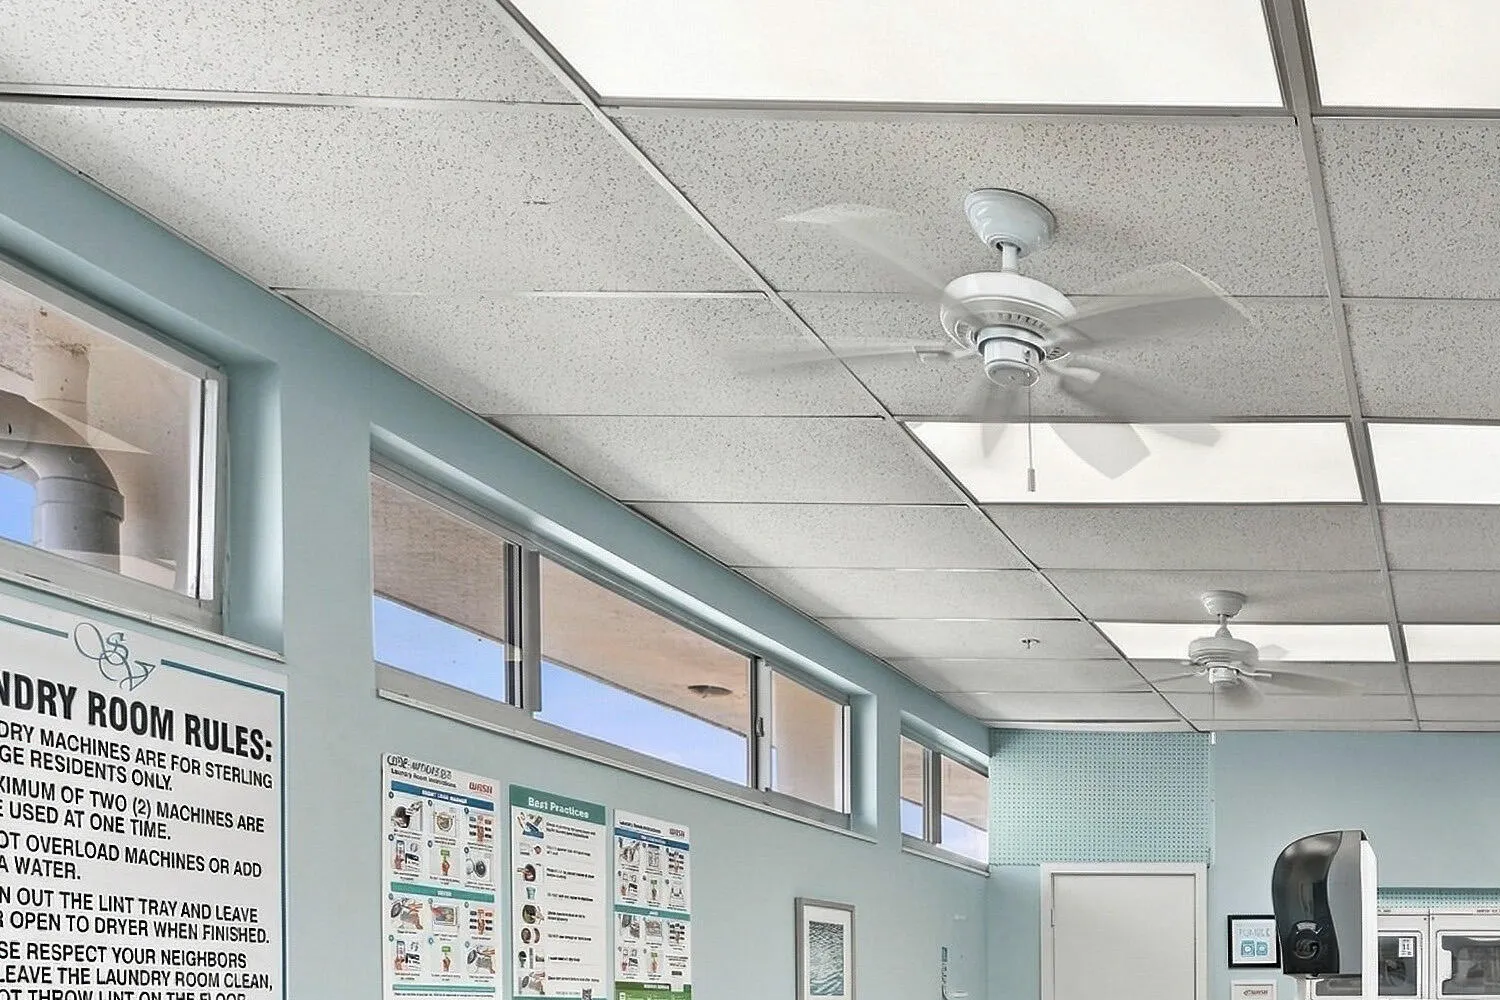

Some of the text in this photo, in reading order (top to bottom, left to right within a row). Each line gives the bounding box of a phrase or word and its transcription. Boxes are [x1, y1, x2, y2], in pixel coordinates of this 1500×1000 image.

[87, 690, 175, 742] ROOM
[184, 712, 273, 763] RULES:
[0, 744, 174, 792] GE RESIDENTS ONLY.
[40, 728, 130, 763] MACHINES
[135, 748, 167, 770] ARE
[171, 755, 201, 775] FOR
[205, 761, 273, 790] STERLING
[9, 800, 59, 824] USED
[64, 809, 85, 828] AT
[90, 815, 125, 834] ONE
[130, 818, 171, 840] TIME.
[61, 786, 85, 804] OF
[89, 790, 127, 812] TWO
[132, 796, 151, 819] (2)
[156, 802, 234, 829] MACHINES
[237, 816, 265, 833] ARE
[528, 796, 590, 819] Best Practices
[14, 855, 81, 880] WATER.
[26, 834, 119, 862] OVERLOAD
[125, 846, 205, 872] MACHINES
[208, 857, 230, 875] OR
[233, 861, 262, 878] ADD
[17, 887, 54, 907] OUT
[59, 890, 94, 911] THE
[99, 895, 134, 914] LINT
[138, 897, 178, 918] TRAY
[181, 902, 212, 920] AND
[215, 905, 259, 924] LEAVE
[10, 910, 60, 931] OPEN
[66, 914, 89, 933] TO
[94, 916, 149, 937] DRYER
[153, 921, 198, 940] WHEN
[203, 924, 270, 944] FINISHED.
[0, 940, 247, 968] SE RESPECT YOUR NEIGHBORS
[57, 966, 91, 985] THE
[96, 968, 171, 987] LAUNDRY
[175, 971, 220, 988] ROOM
[224, 972, 273, 991] CLEAN,
